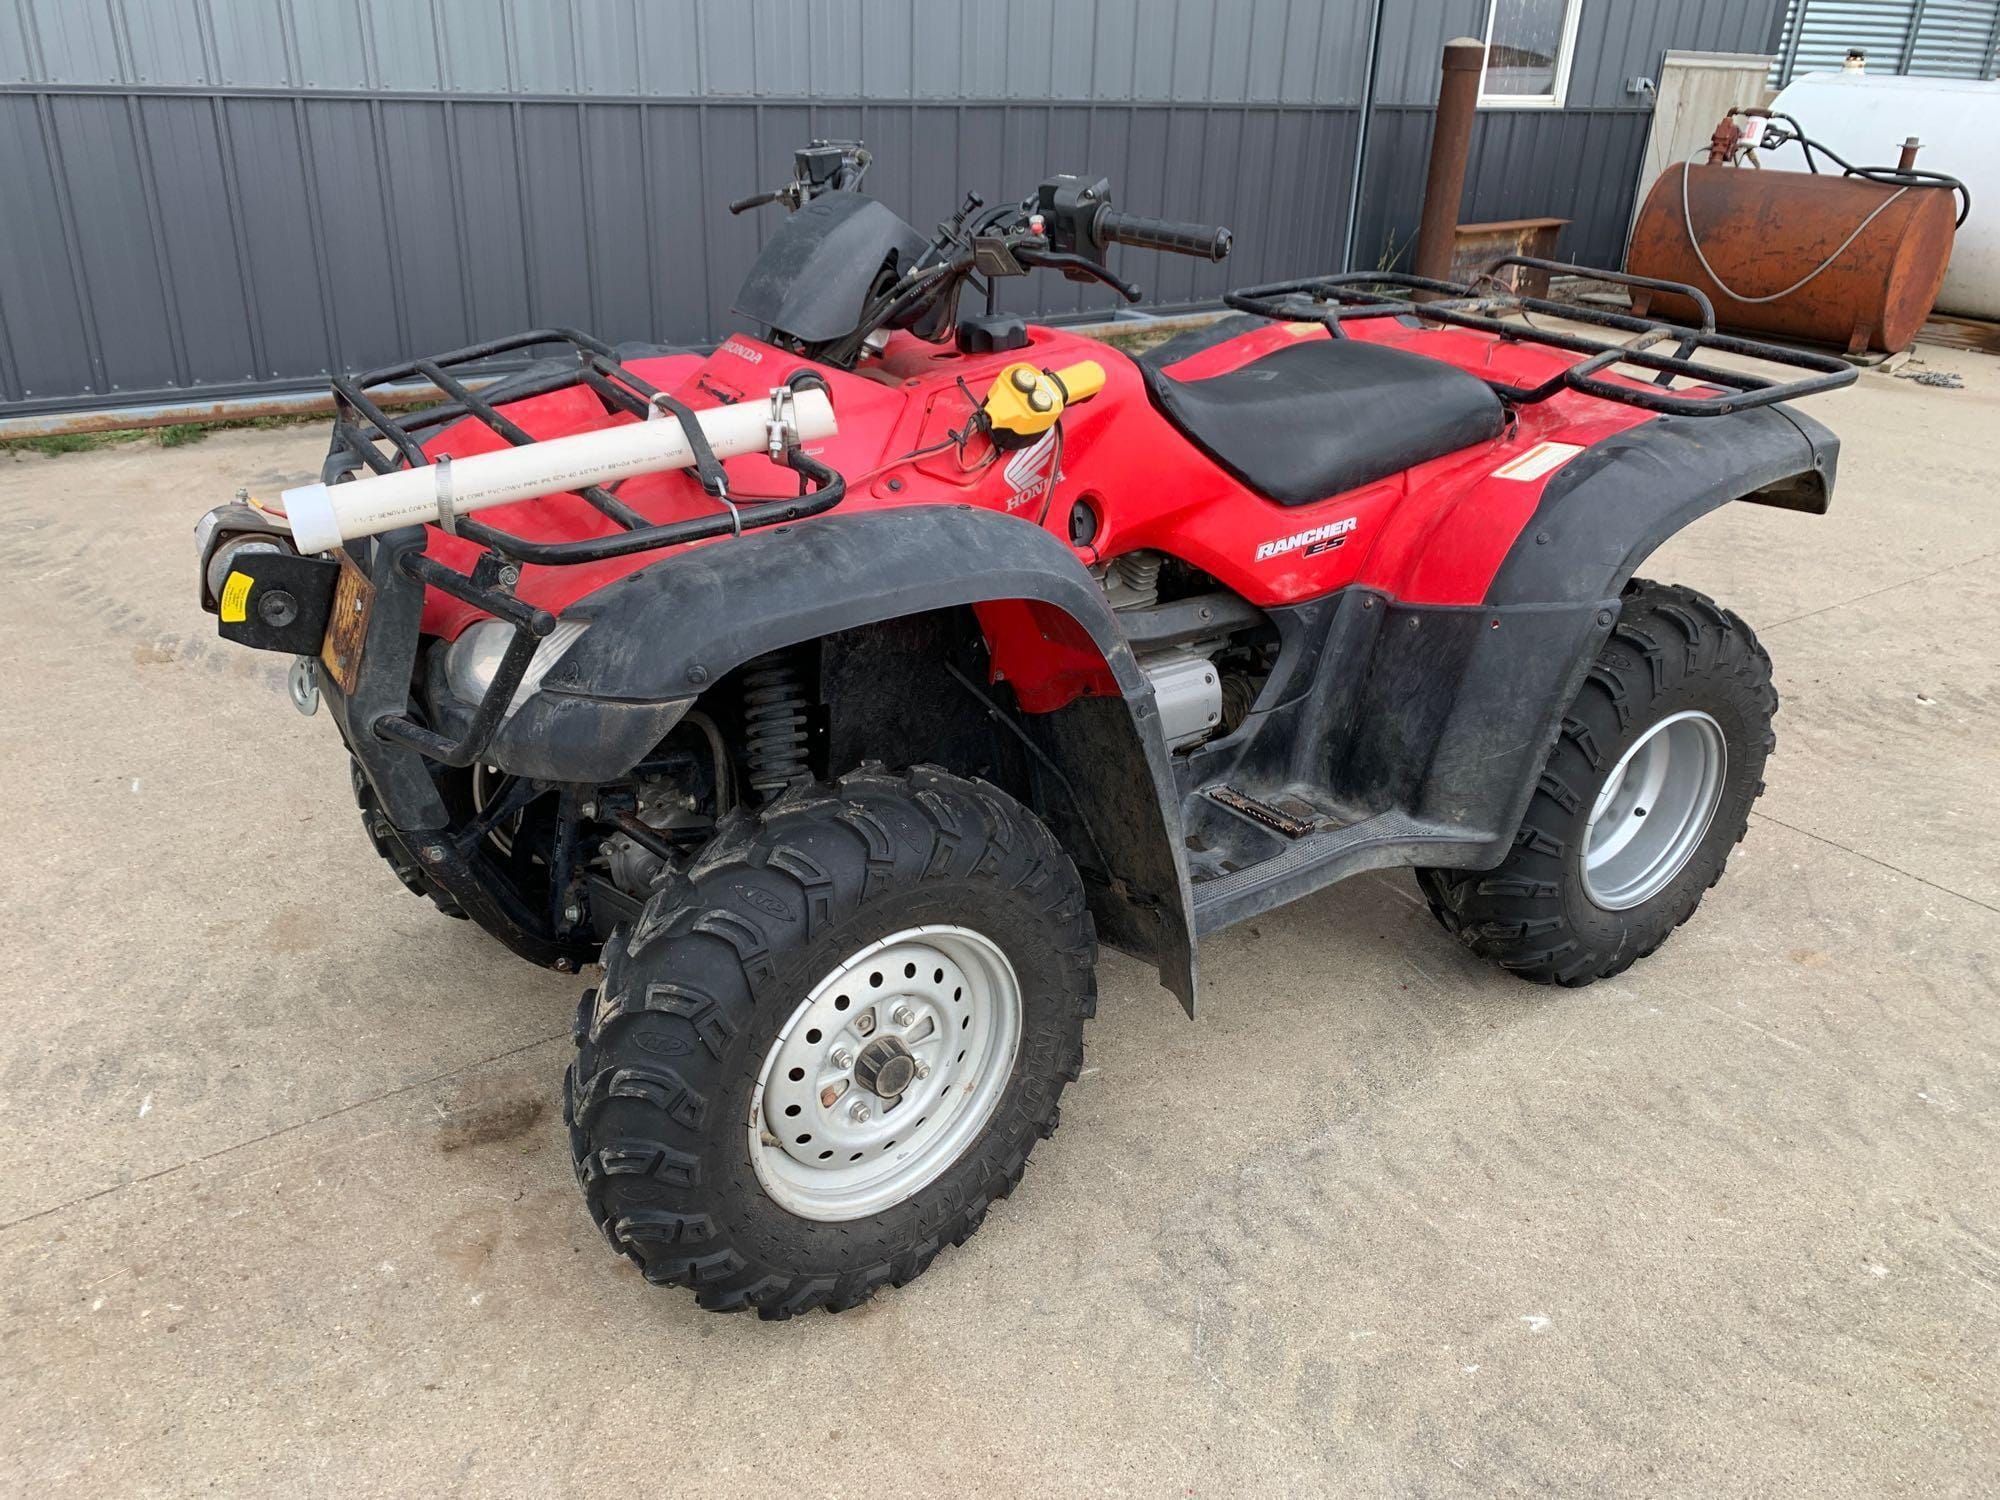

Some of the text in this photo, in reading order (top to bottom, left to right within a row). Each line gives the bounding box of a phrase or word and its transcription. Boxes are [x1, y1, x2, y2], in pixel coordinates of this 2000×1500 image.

[721, 340, 763, 364] HONDA
[1256, 516, 1358, 560] RANCHER
[1304, 535, 1347, 558] ES
